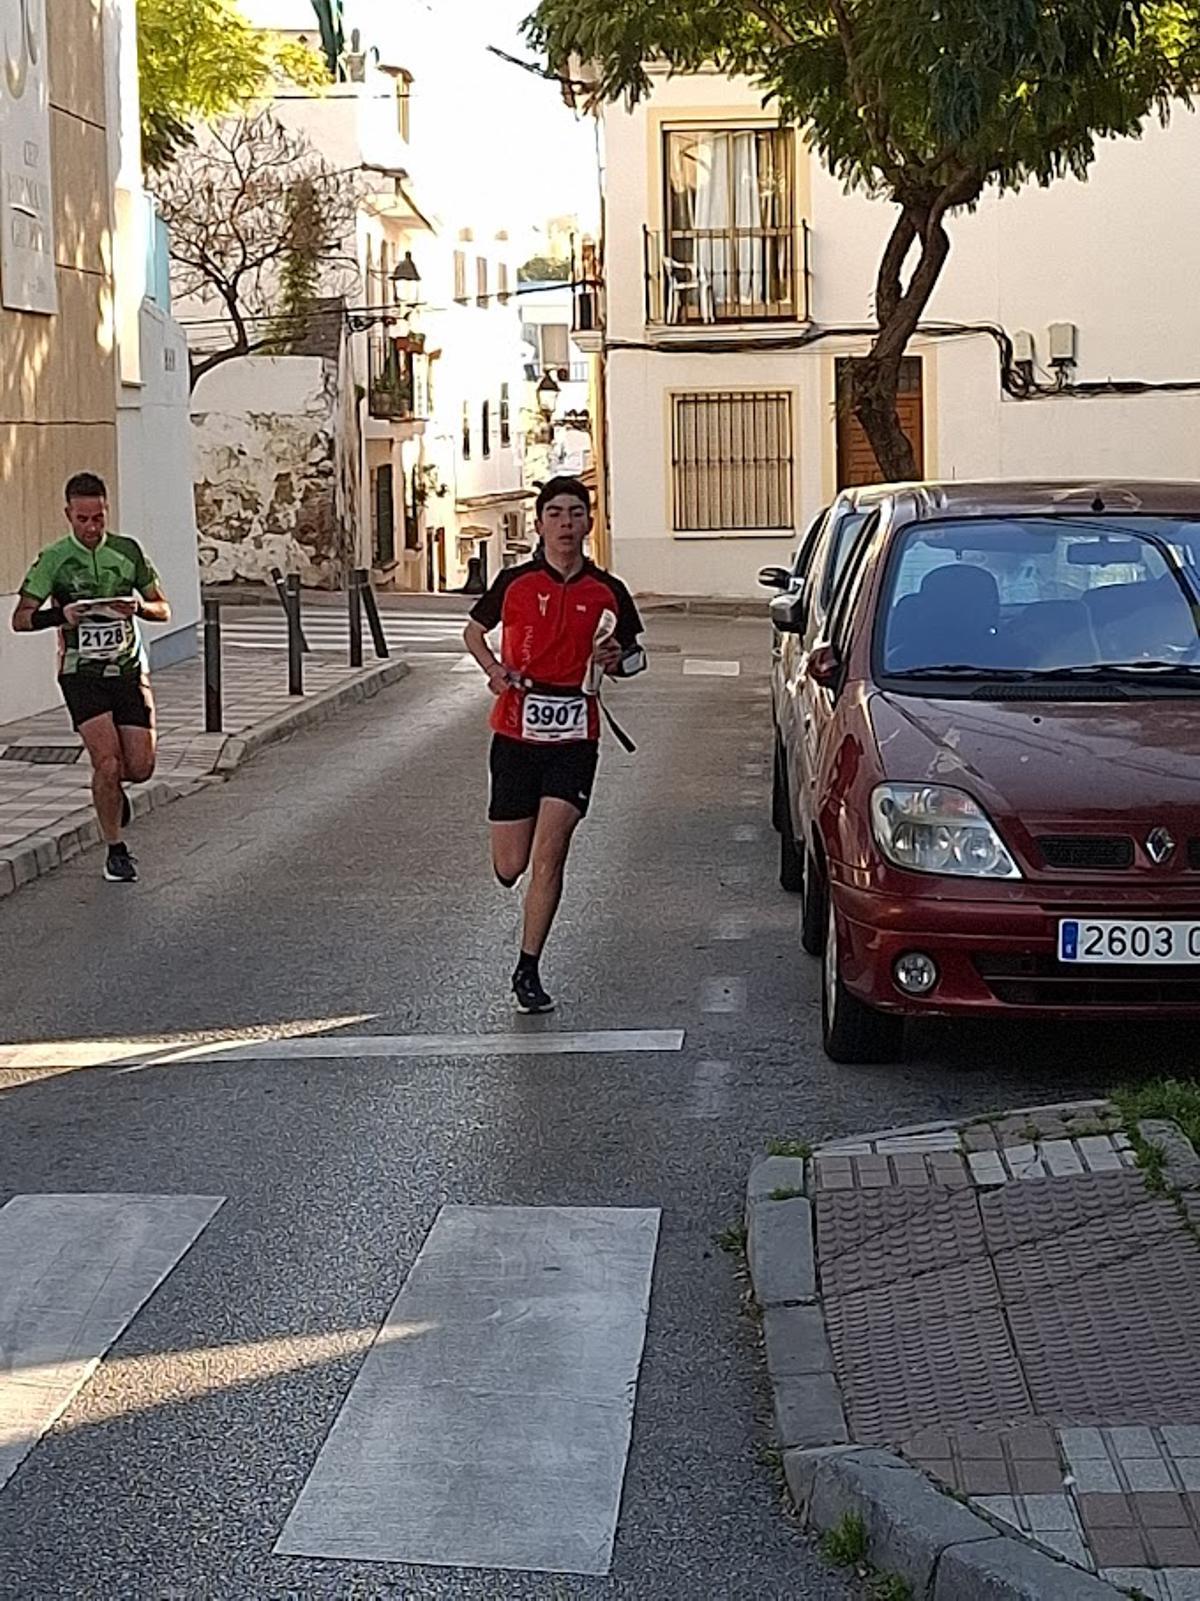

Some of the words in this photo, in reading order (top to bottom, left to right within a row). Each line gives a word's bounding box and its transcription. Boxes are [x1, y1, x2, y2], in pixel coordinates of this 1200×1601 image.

[82, 628, 124, 647] 2128
[526, 704, 583, 726] 3907
[1084, 926, 1173, 957] 2603
